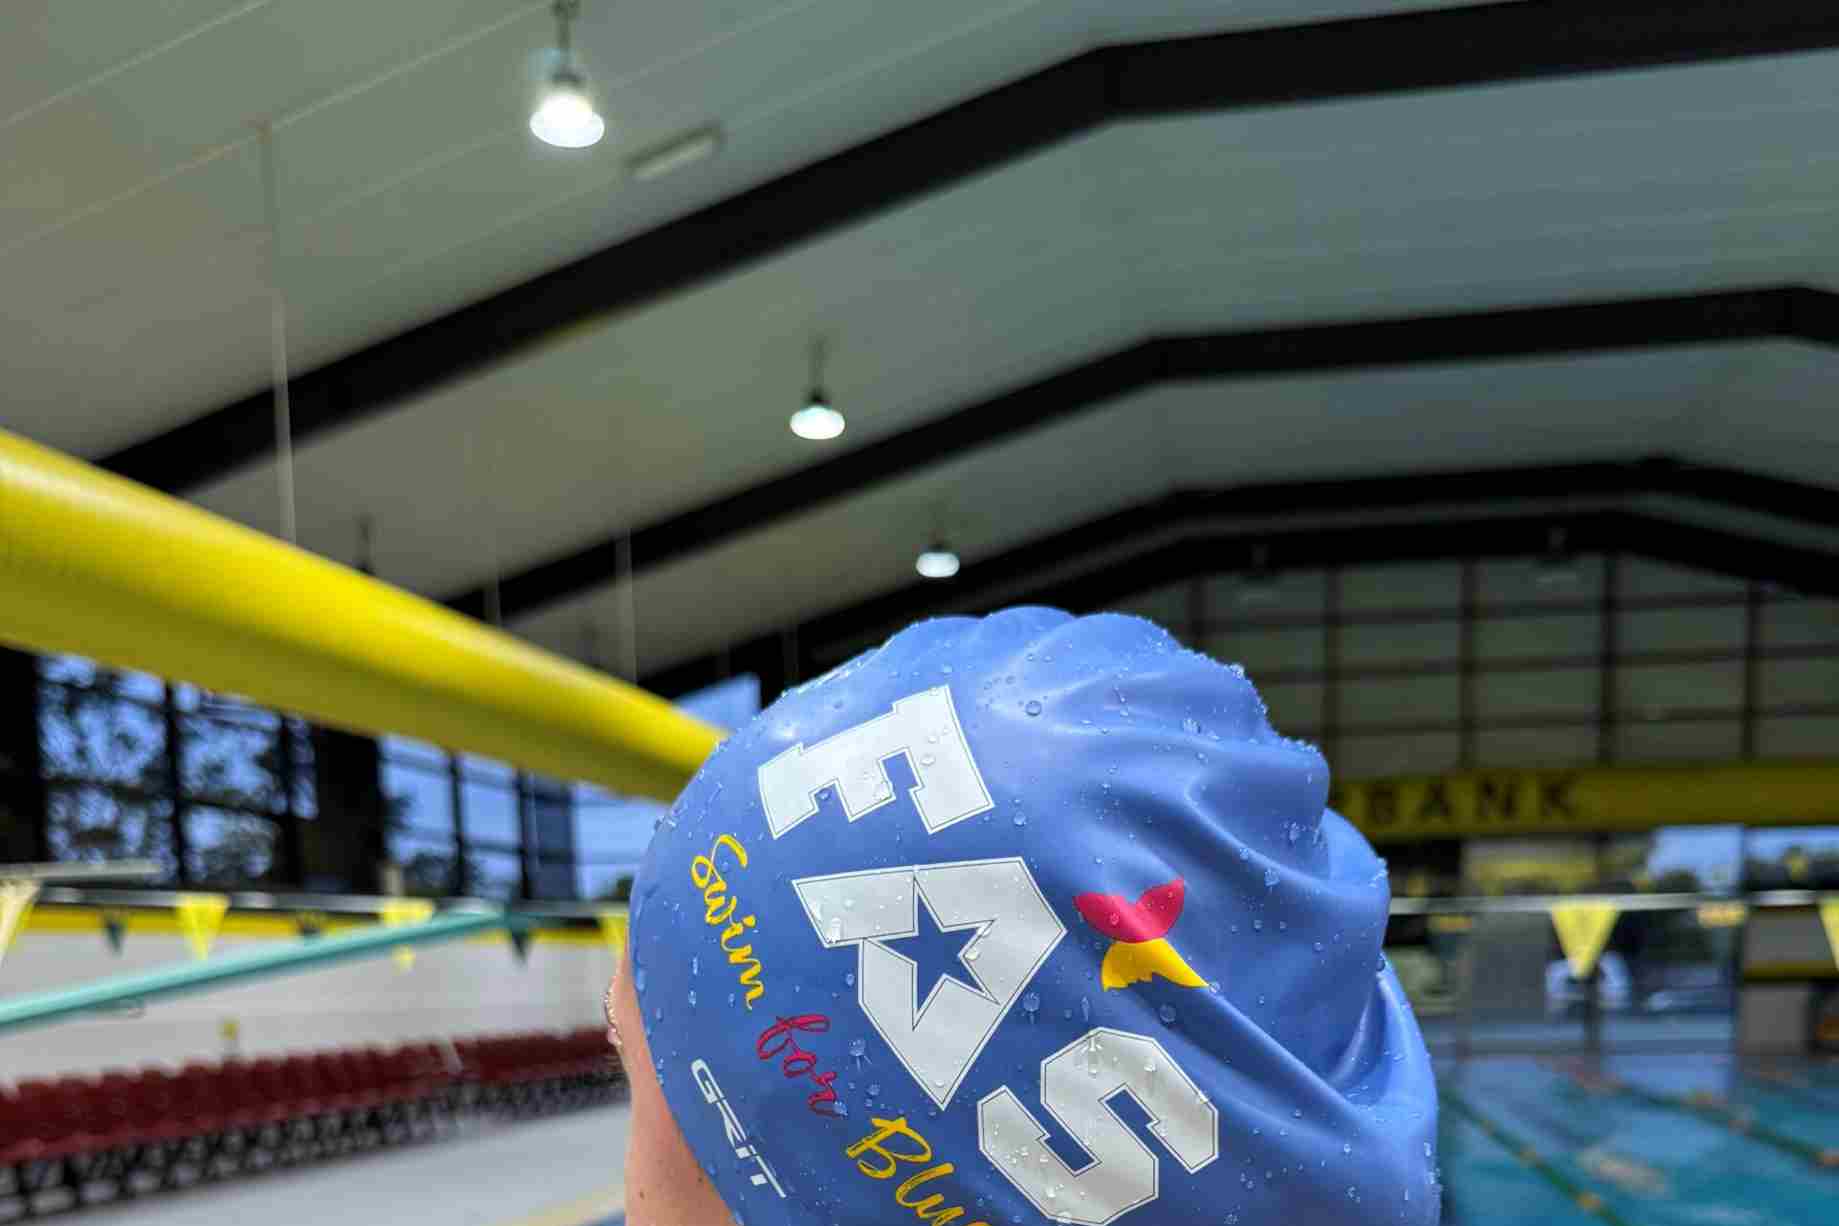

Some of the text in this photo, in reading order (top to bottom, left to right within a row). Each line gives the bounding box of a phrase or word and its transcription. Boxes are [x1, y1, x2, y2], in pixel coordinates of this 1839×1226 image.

[1332, 776, 1577, 824] BANK
[691, 833, 764, 1010] Swim
[756, 1013, 845, 1118] for
